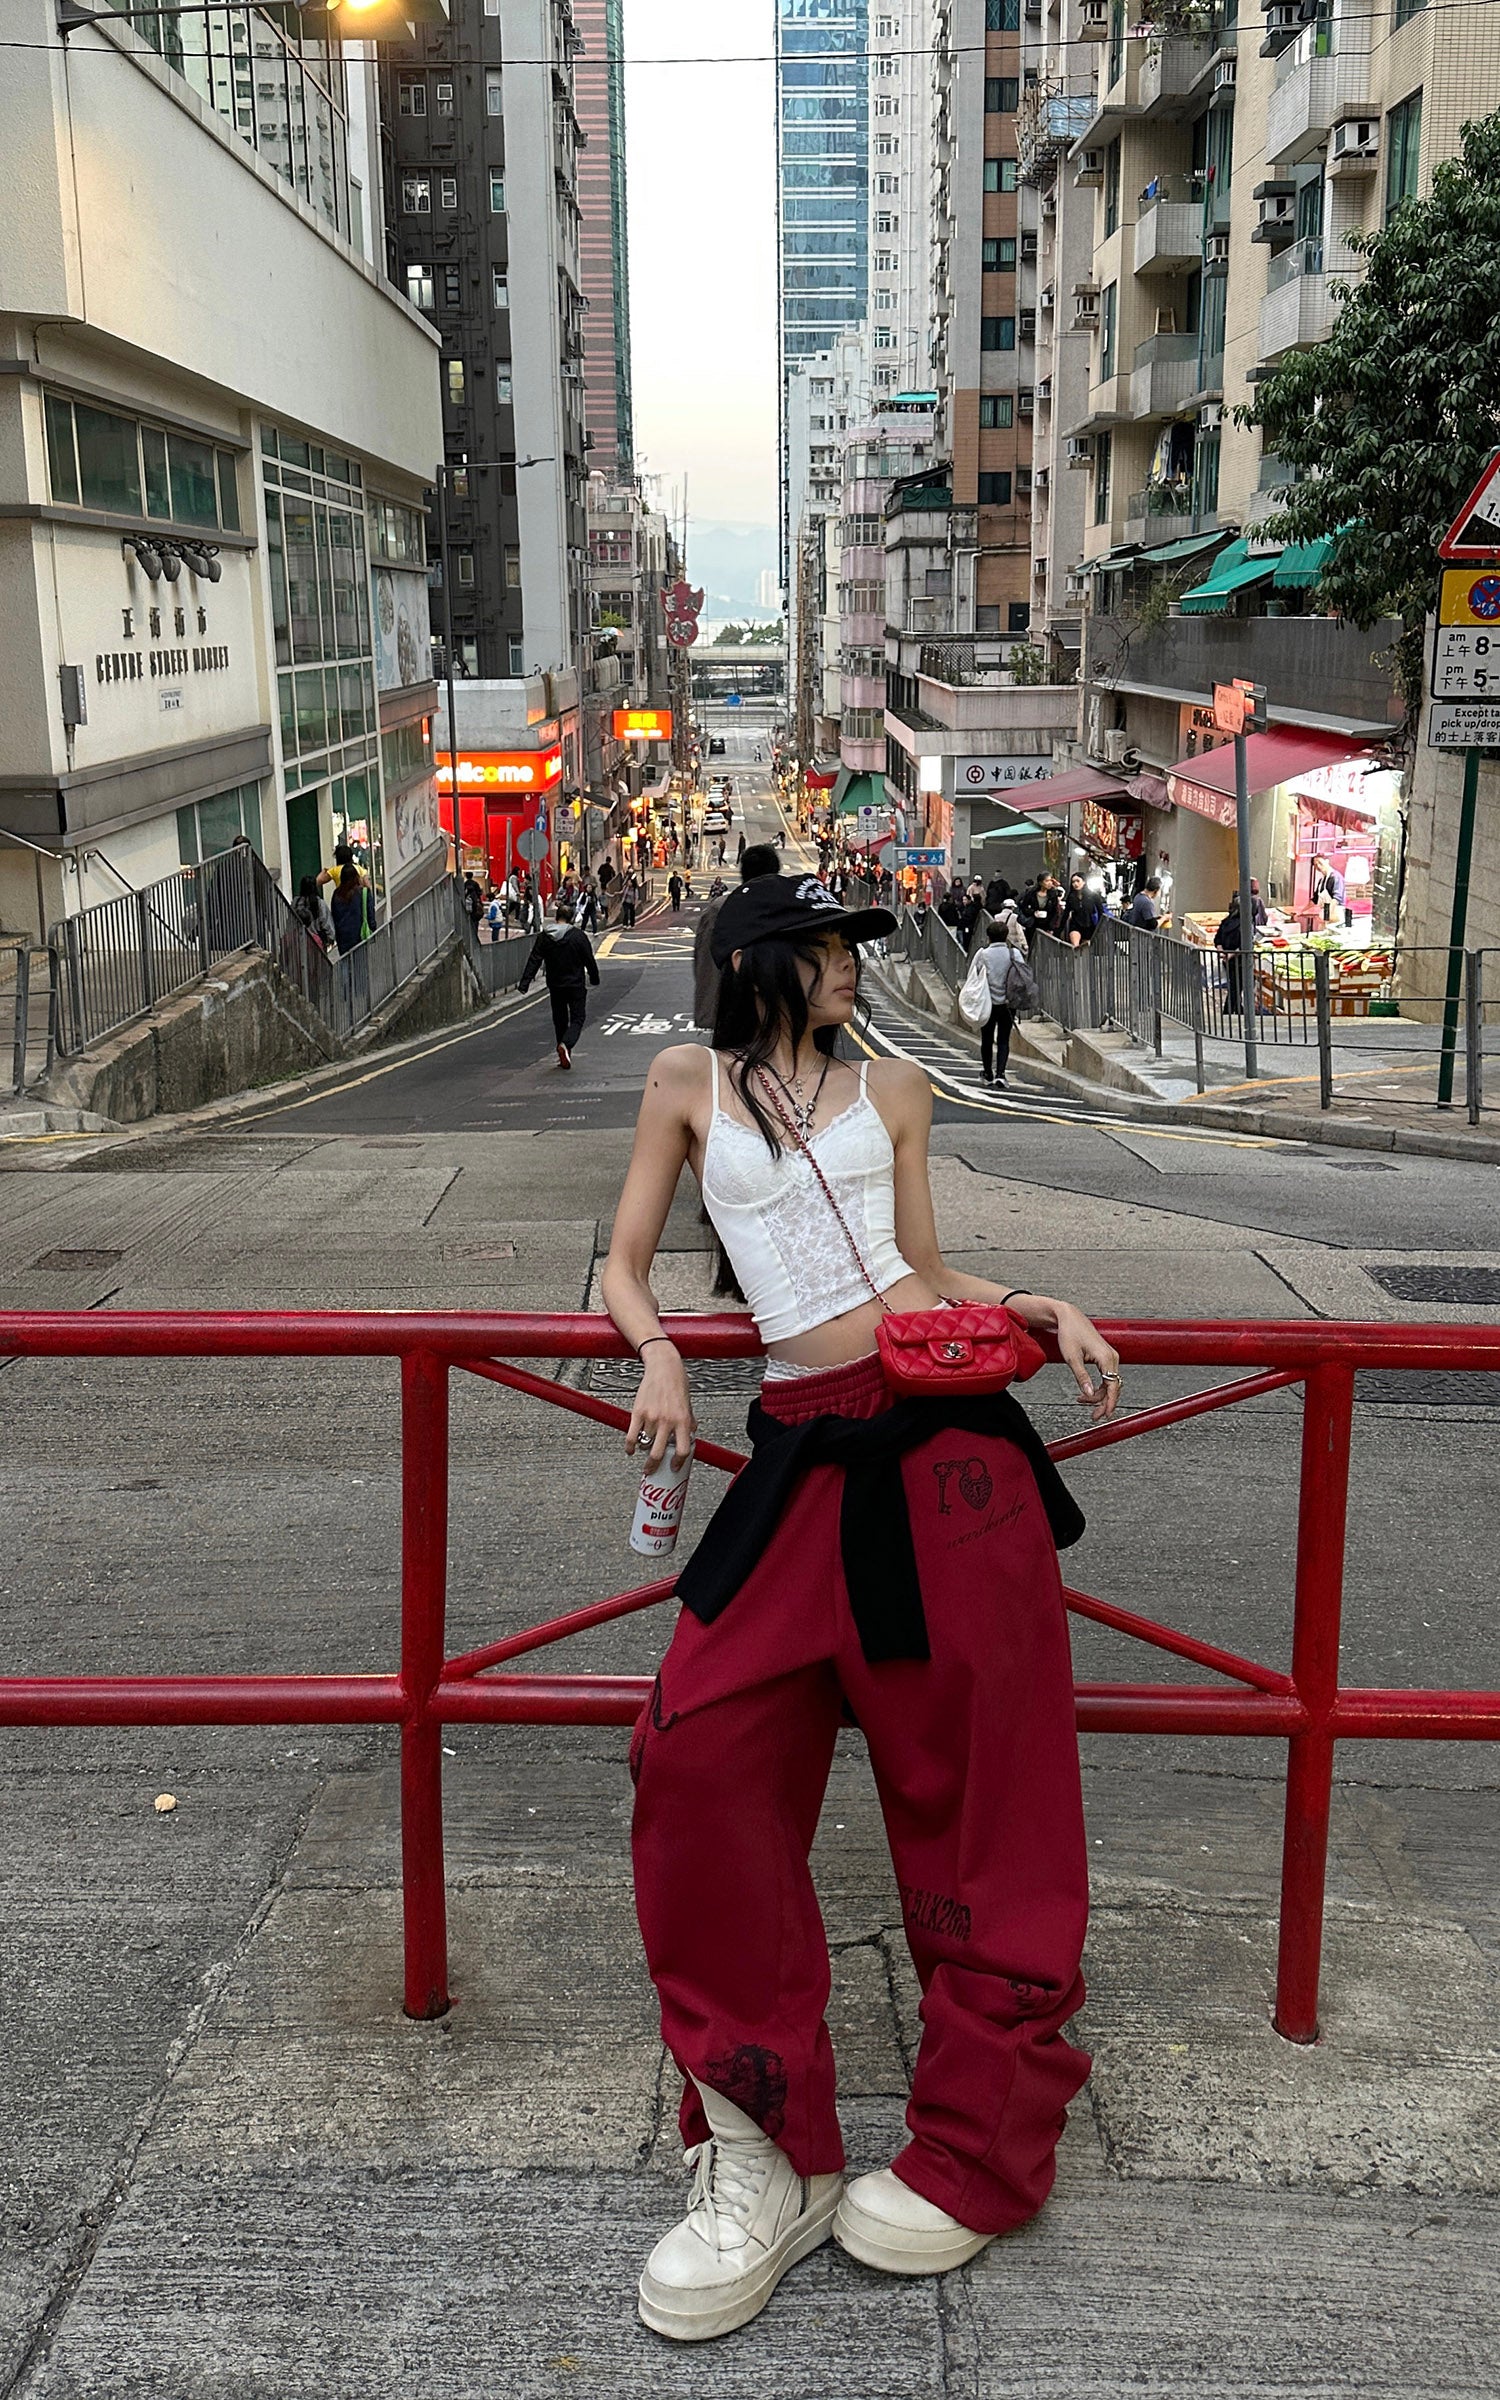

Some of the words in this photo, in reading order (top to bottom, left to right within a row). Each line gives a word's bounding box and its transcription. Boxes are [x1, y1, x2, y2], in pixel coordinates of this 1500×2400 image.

[1487, 502, 1500, 523] 1:
[1442, 645, 1471, 657] 上午
[96, 652, 143, 682] CENTRE
[149, 649, 188, 677] STREET
[193, 646, 229, 671] MARKET
[1446, 666, 1464, 675] pm
[1440, 677, 1468, 689] 下午
[1455, 709, 1488, 718] Except
[1442, 720, 1462, 729] pick
[1435, 731, 1500, 743] 的士上落客
[651, 1512, 673, 1520] plus
